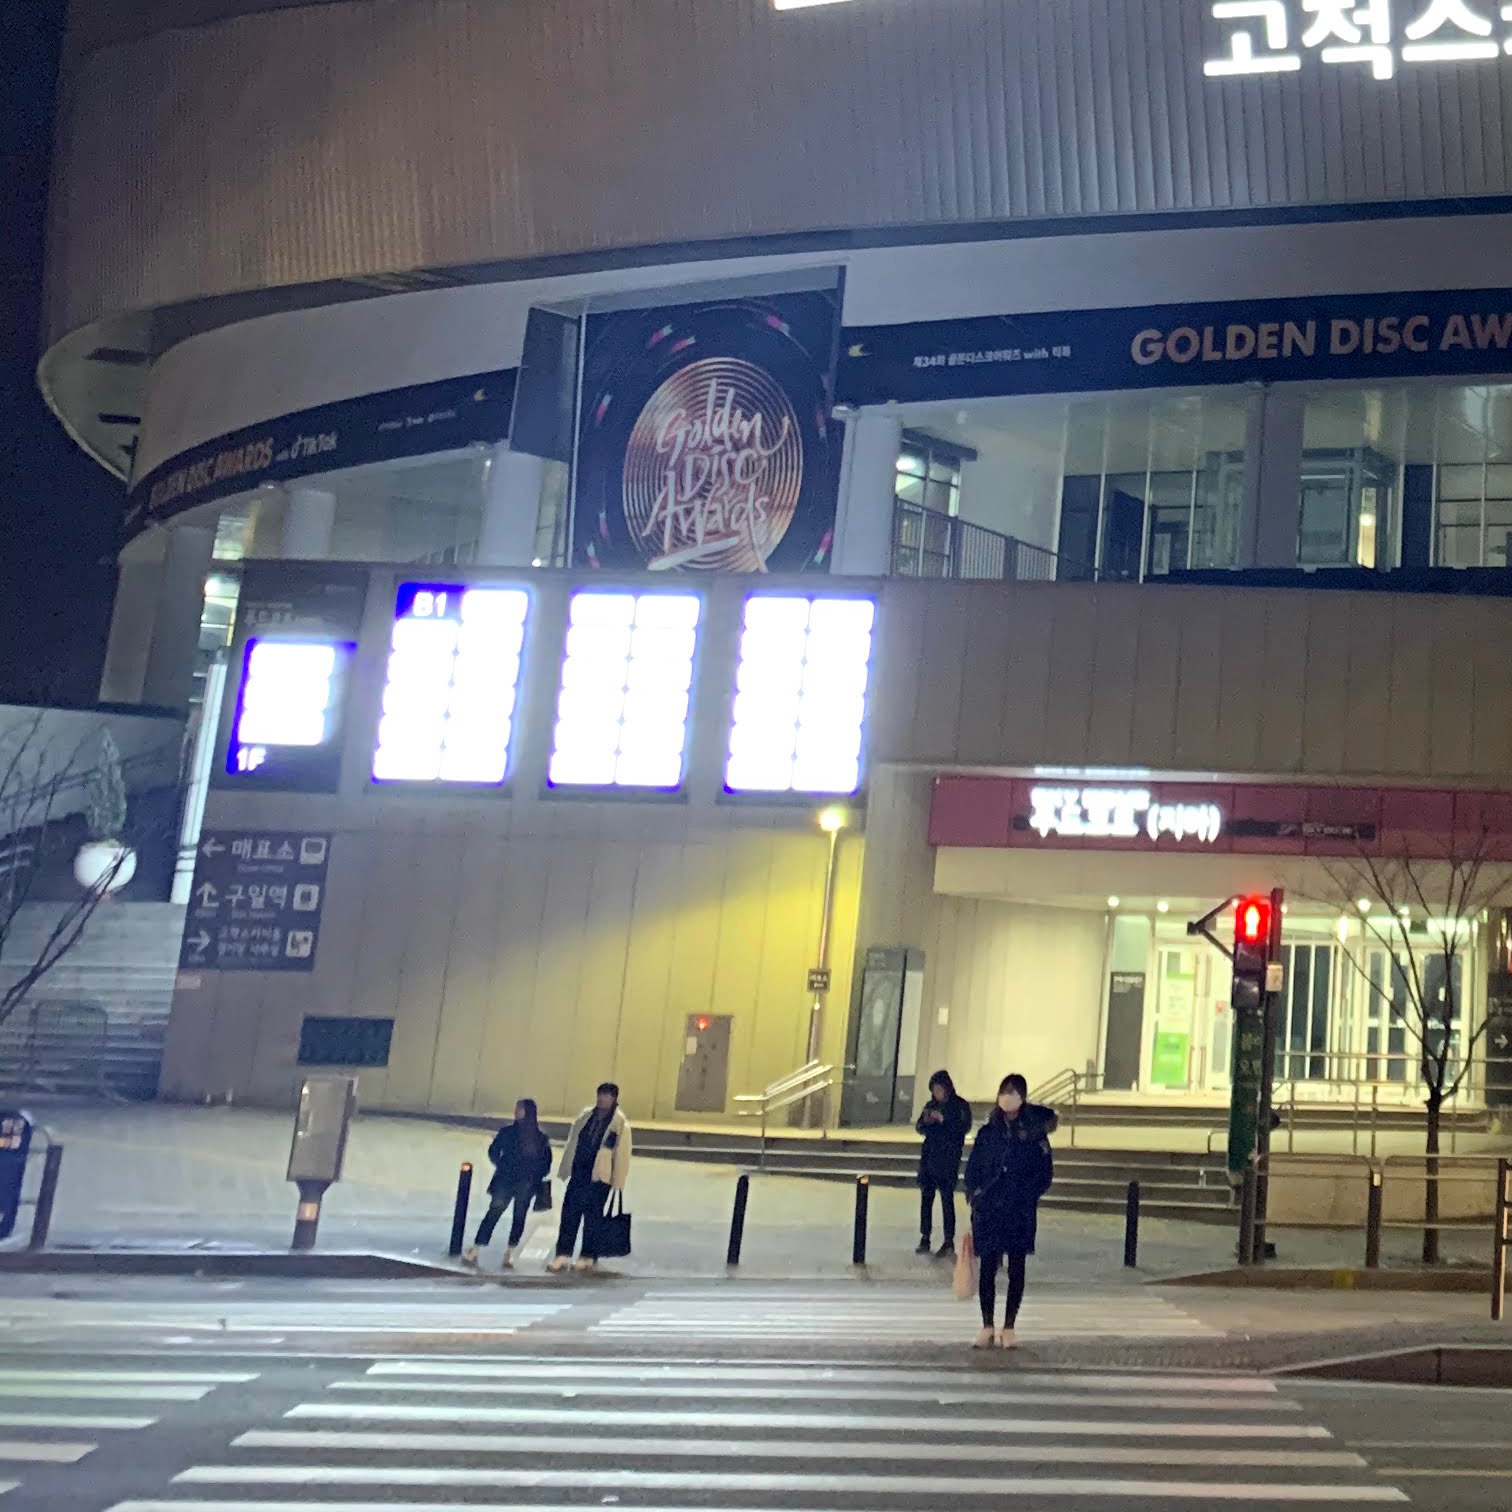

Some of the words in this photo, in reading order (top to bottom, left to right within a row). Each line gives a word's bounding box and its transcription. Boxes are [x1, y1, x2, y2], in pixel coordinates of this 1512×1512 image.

[1023, 347, 1049, 360] with
[1129, 319, 1317, 367] GOLDEN
[1327, 313, 1430, 356] DISC
[655, 378, 789, 465] Golden
[412, 590, 448, 617] B1
[236, 745, 267, 773] 1F
[231, 838, 295, 861] 매표소
[224, 884, 288, 911] 구일역
